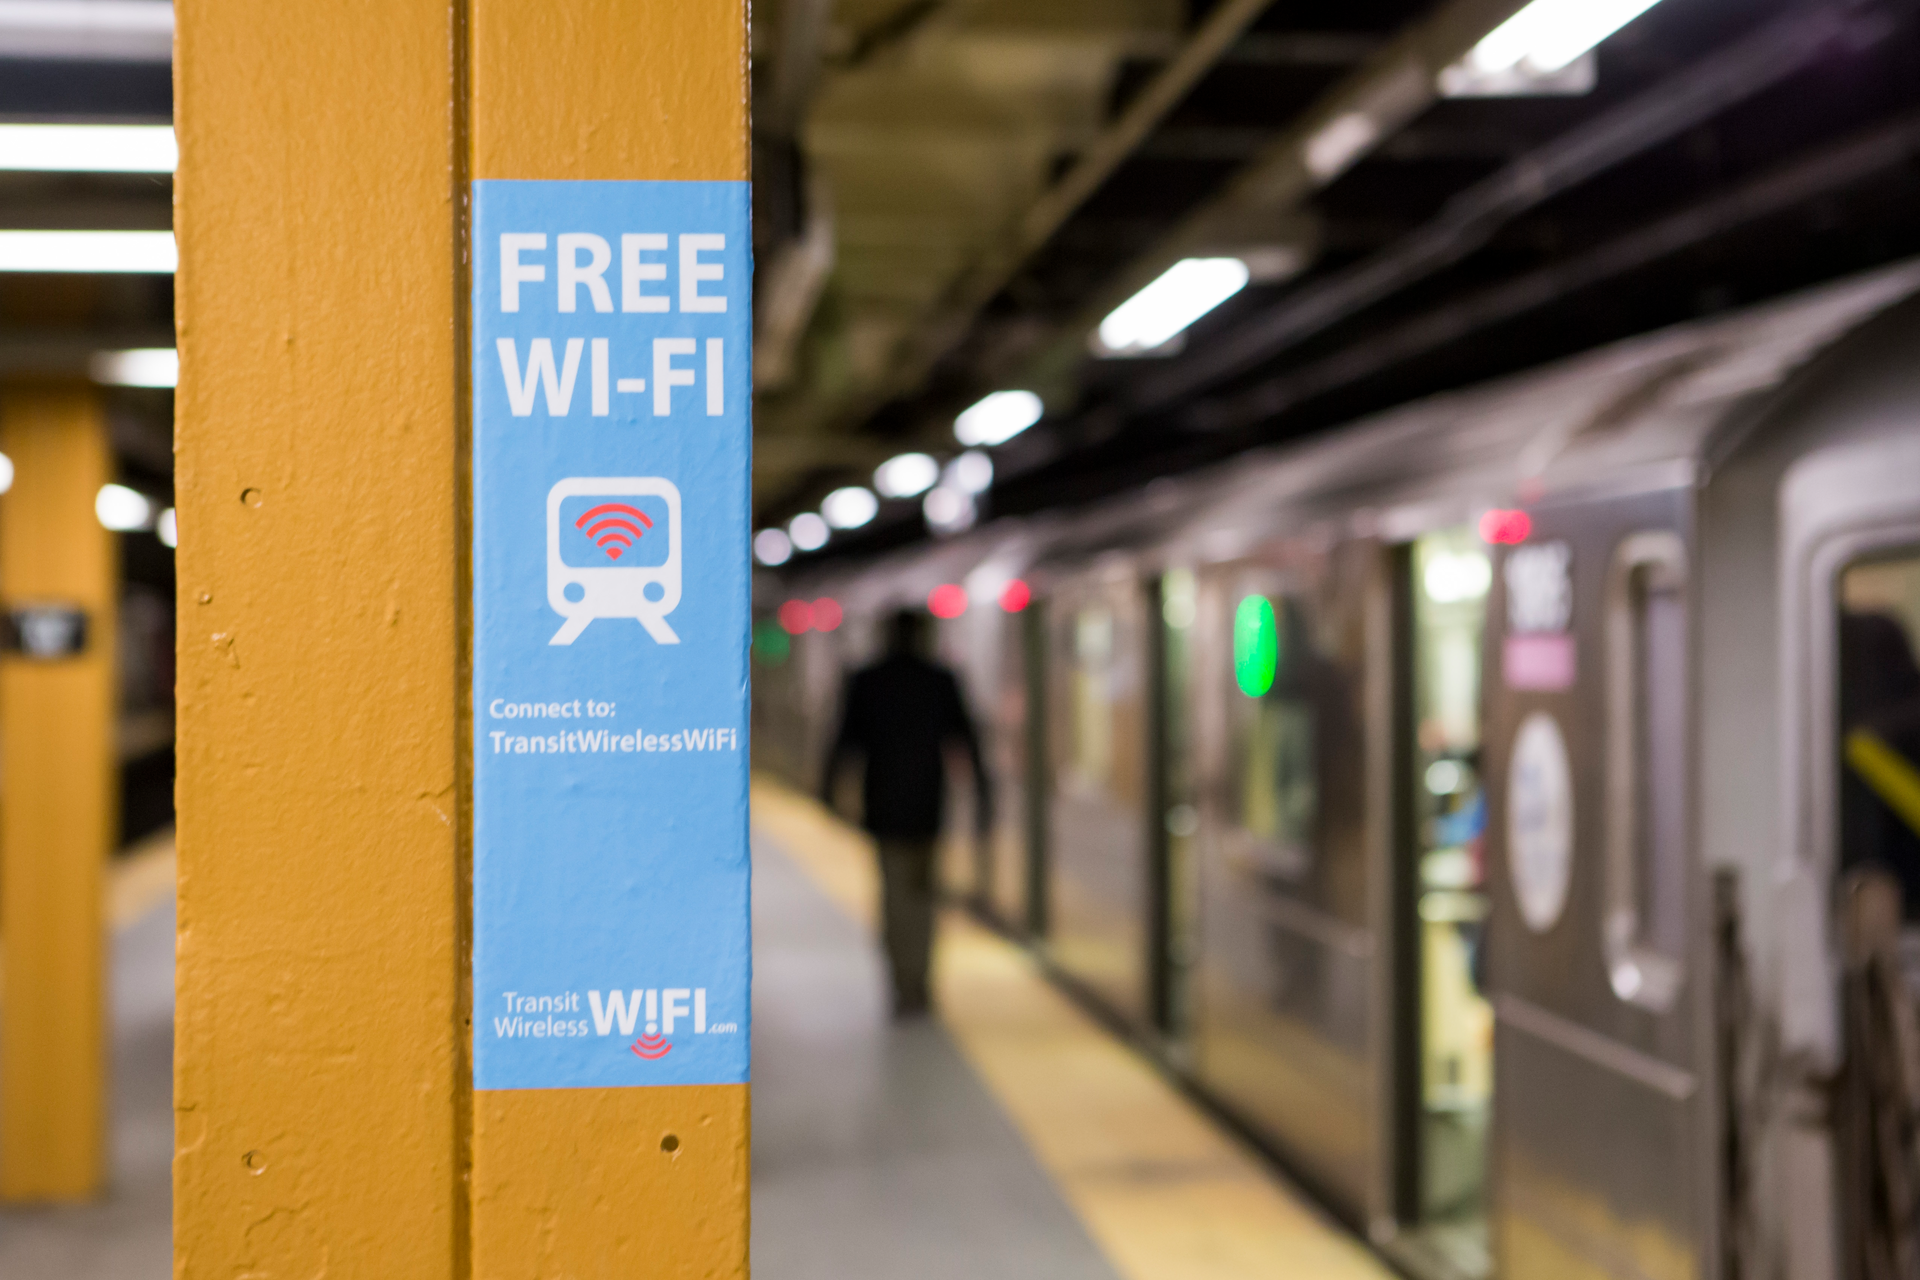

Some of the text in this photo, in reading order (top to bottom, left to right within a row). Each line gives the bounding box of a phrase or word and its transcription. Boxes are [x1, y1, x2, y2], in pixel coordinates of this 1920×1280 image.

[500, 232, 728, 313] FREE
[496, 337, 724, 417] WI-FI
[489, 698, 616, 719] Connect to:
[488, 728, 737, 754] TransitWirelessWiFi
[502, 991, 580, 1014] Transit
[494, 1015, 589, 1038] Wireless
